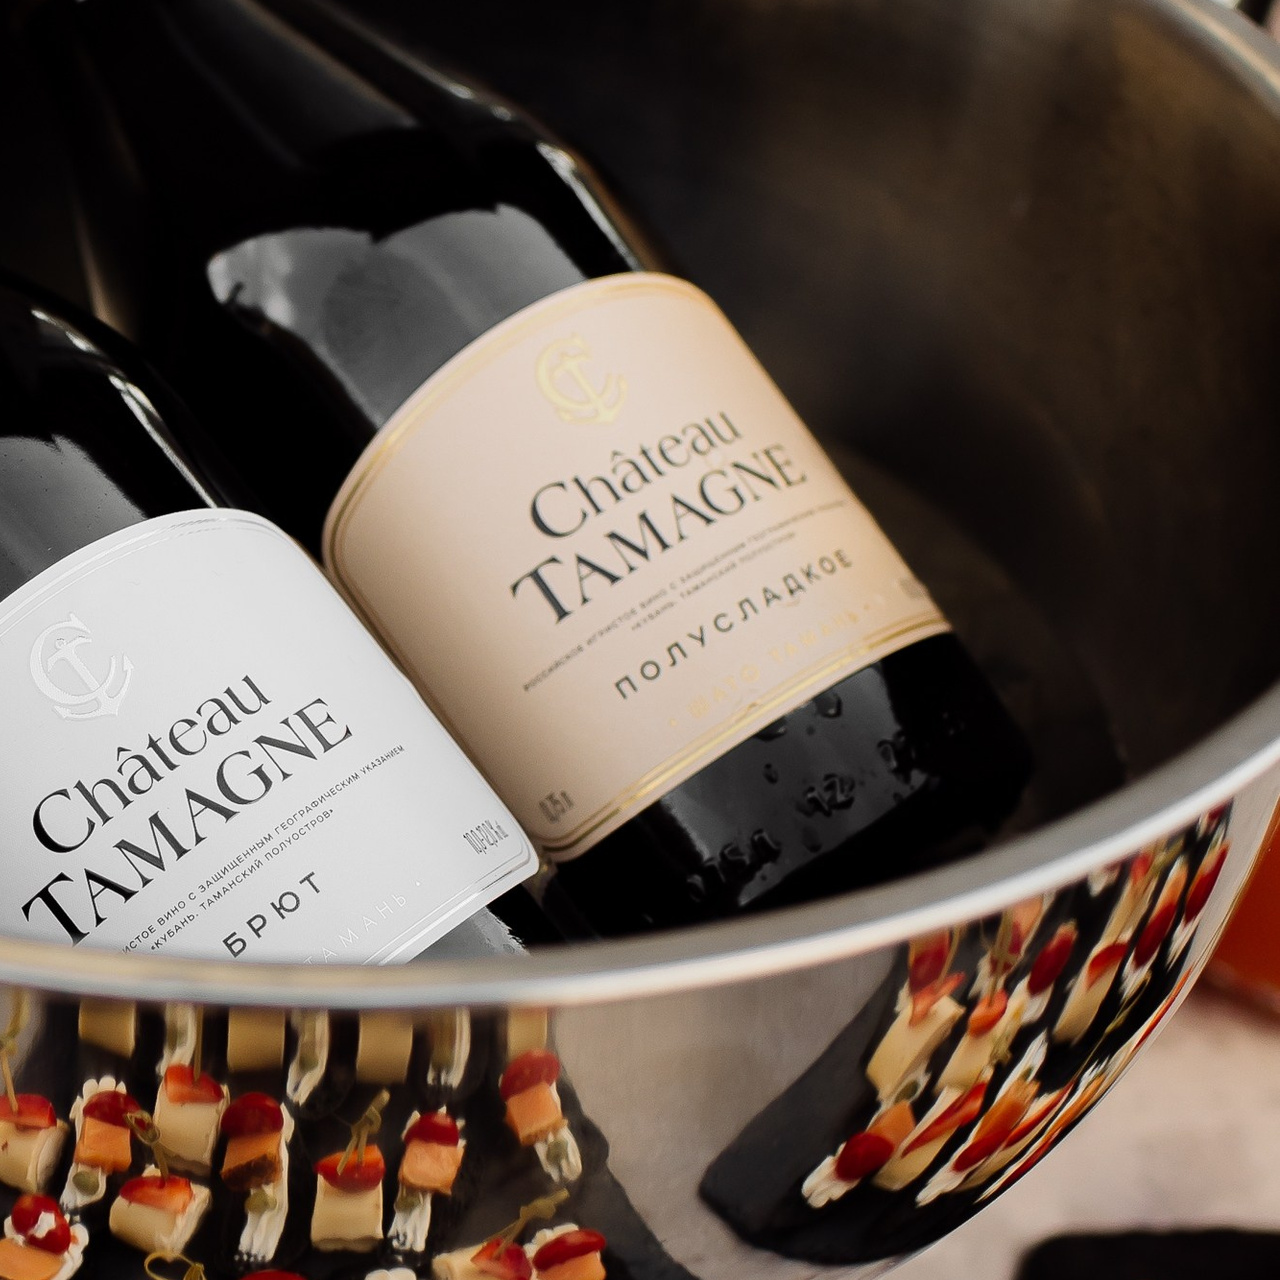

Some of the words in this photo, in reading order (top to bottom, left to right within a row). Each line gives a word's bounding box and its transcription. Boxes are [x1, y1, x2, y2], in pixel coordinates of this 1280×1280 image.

[510, 443, 807, 625] TAMAGNE
[529, 410, 742, 540] Château
[614, 549, 853, 700] ПОЛУСЛАДКОЕ
[21, 698, 353, 947] TAMAGNE
[31, 674, 272, 854] Château
[122, 924, 157, 955] ИСТОЕ
[156, 900, 187, 927] ВИНО
[188, 891, 198, 902] С
[198, 832, 275, 894] ЗАЩИЩЕННЫМ
[274, 771, 361, 836] ГЕОГРАФИЧЕСКИМ
[360, 744, 406, 774] УКАЗАНИЕМ
[199, 858, 265, 912] ТАМАНСКИЙ
[264, 807, 335, 862] ПОЛУОСТРОВ»
[222, 871, 322, 959] БРЮТ
